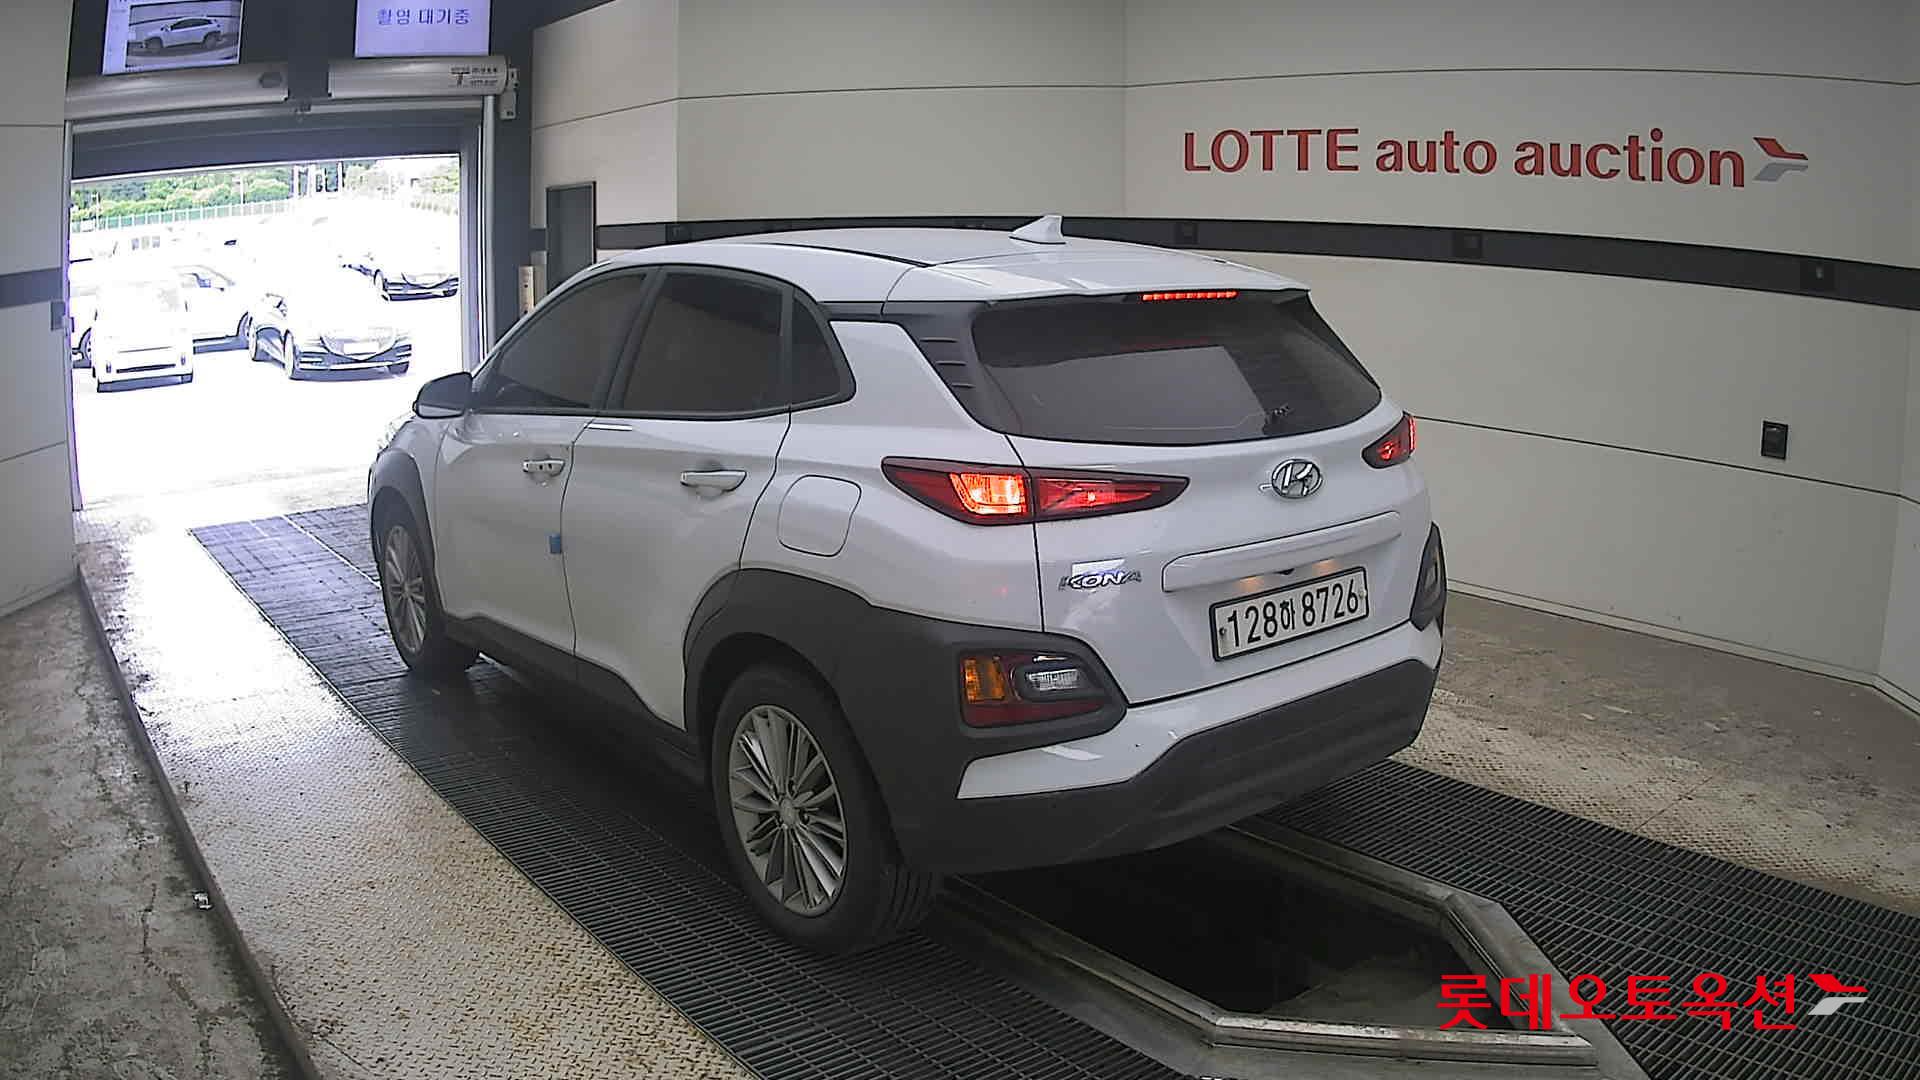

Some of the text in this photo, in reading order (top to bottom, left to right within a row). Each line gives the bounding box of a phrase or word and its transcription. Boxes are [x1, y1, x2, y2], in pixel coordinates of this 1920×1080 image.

[419, 8, 469, 25] 대기중
[1183, 127, 1745, 188] LOTTE auto auction
[1058, 569, 1143, 592] KONA
